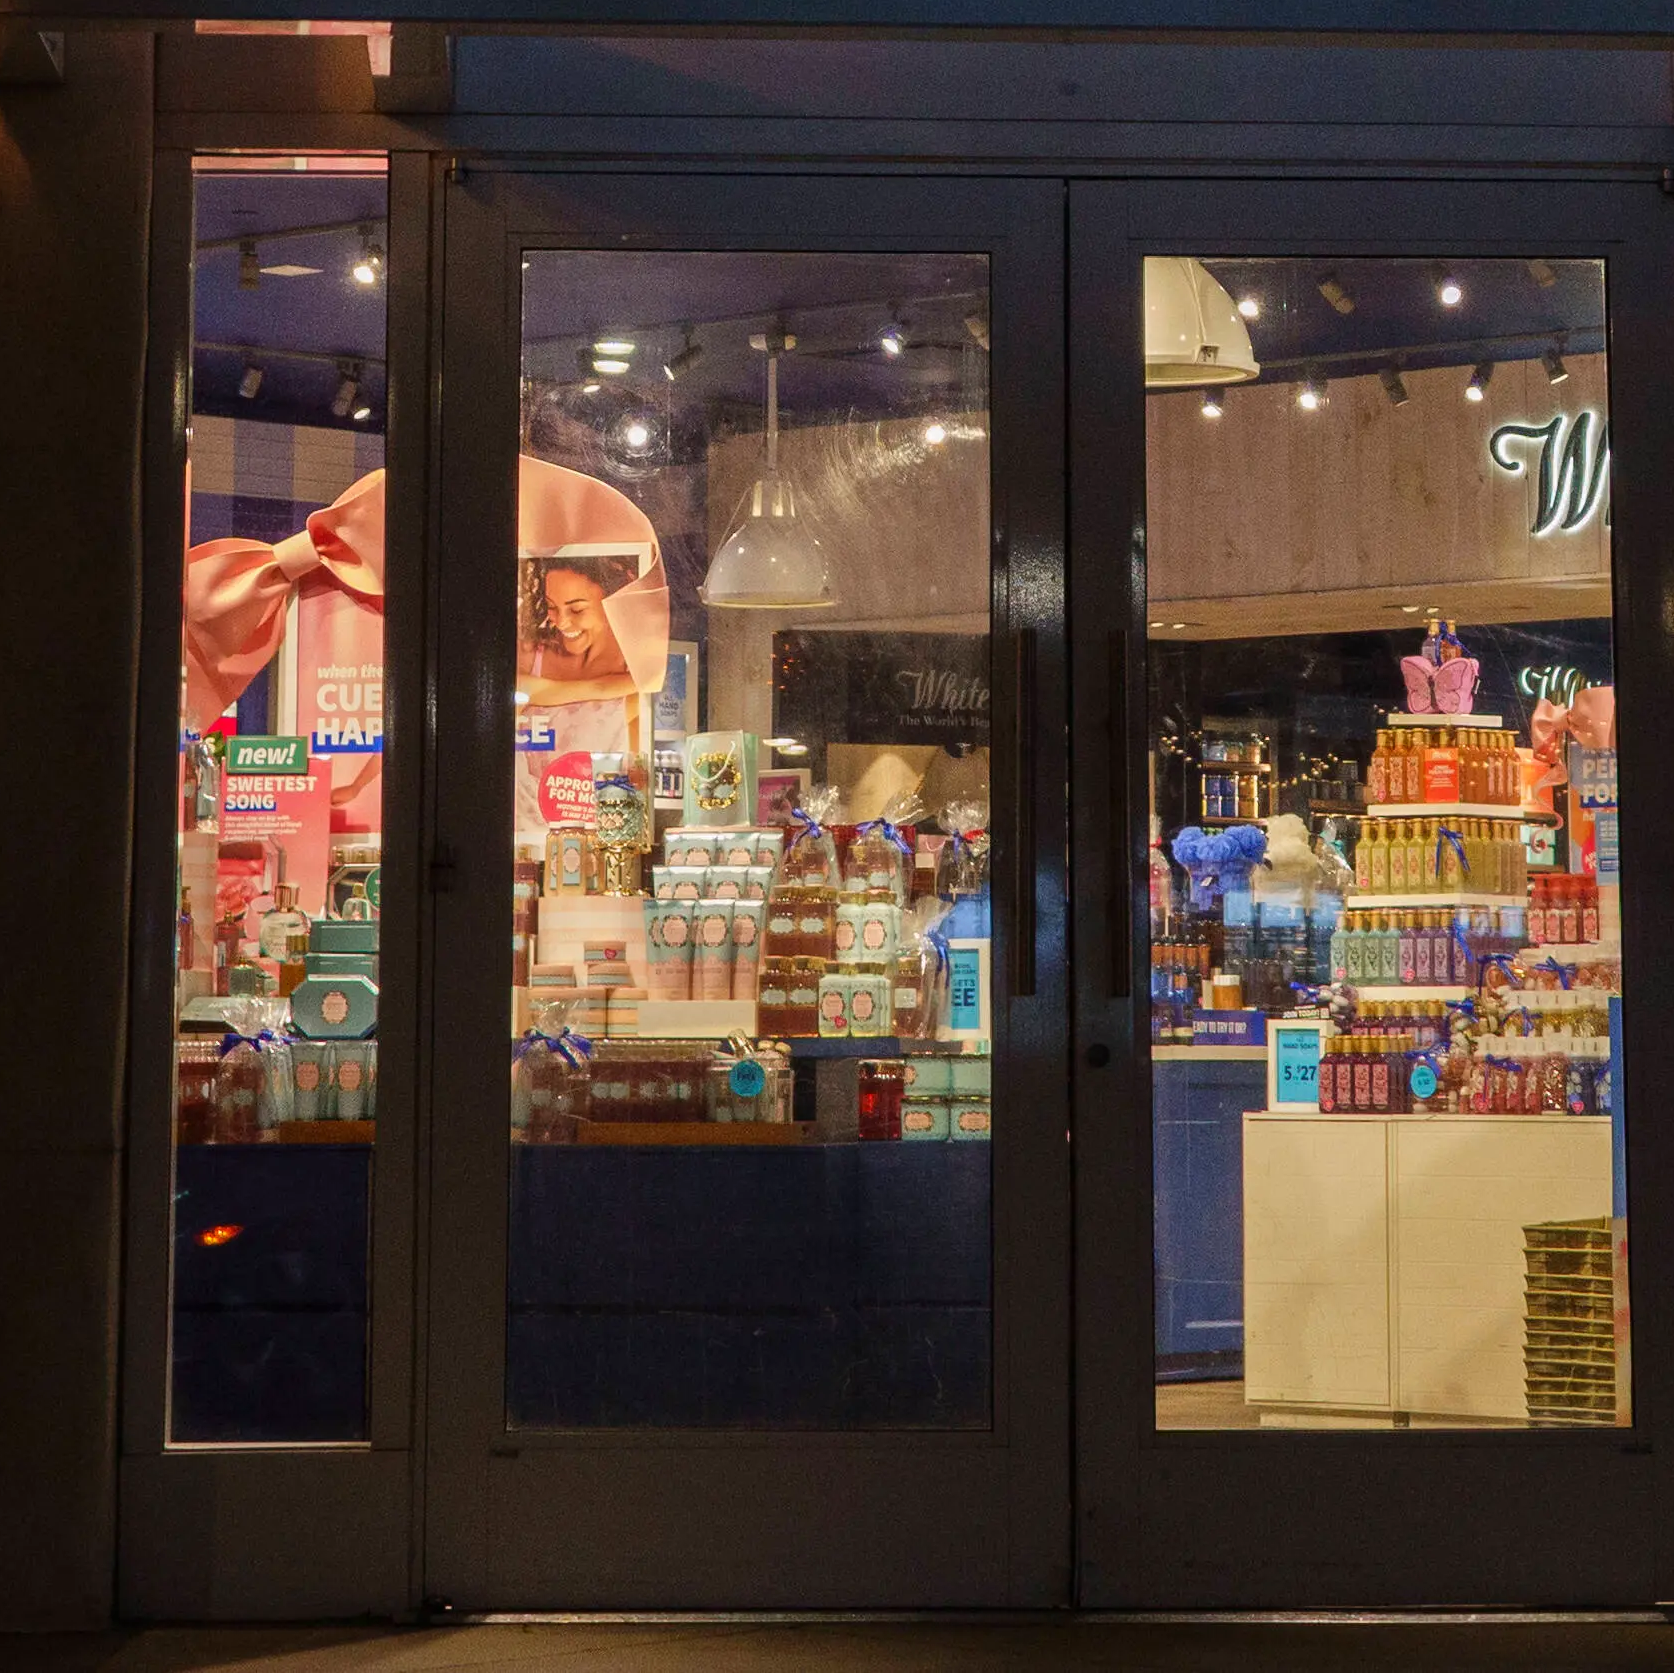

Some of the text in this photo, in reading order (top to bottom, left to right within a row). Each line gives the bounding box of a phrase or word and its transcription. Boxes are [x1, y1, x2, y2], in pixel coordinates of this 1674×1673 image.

[317, 663, 357, 679] when
[896, 668, 990, 714] White
[899, 714, 920, 726] The
[237, 743, 297, 765] new!
[227, 776, 317, 792] SWEETEST
[225, 794, 275, 810] SONG
[549, 788, 575, 802] FOR
[1284, 1065, 1293, 1081] 5
